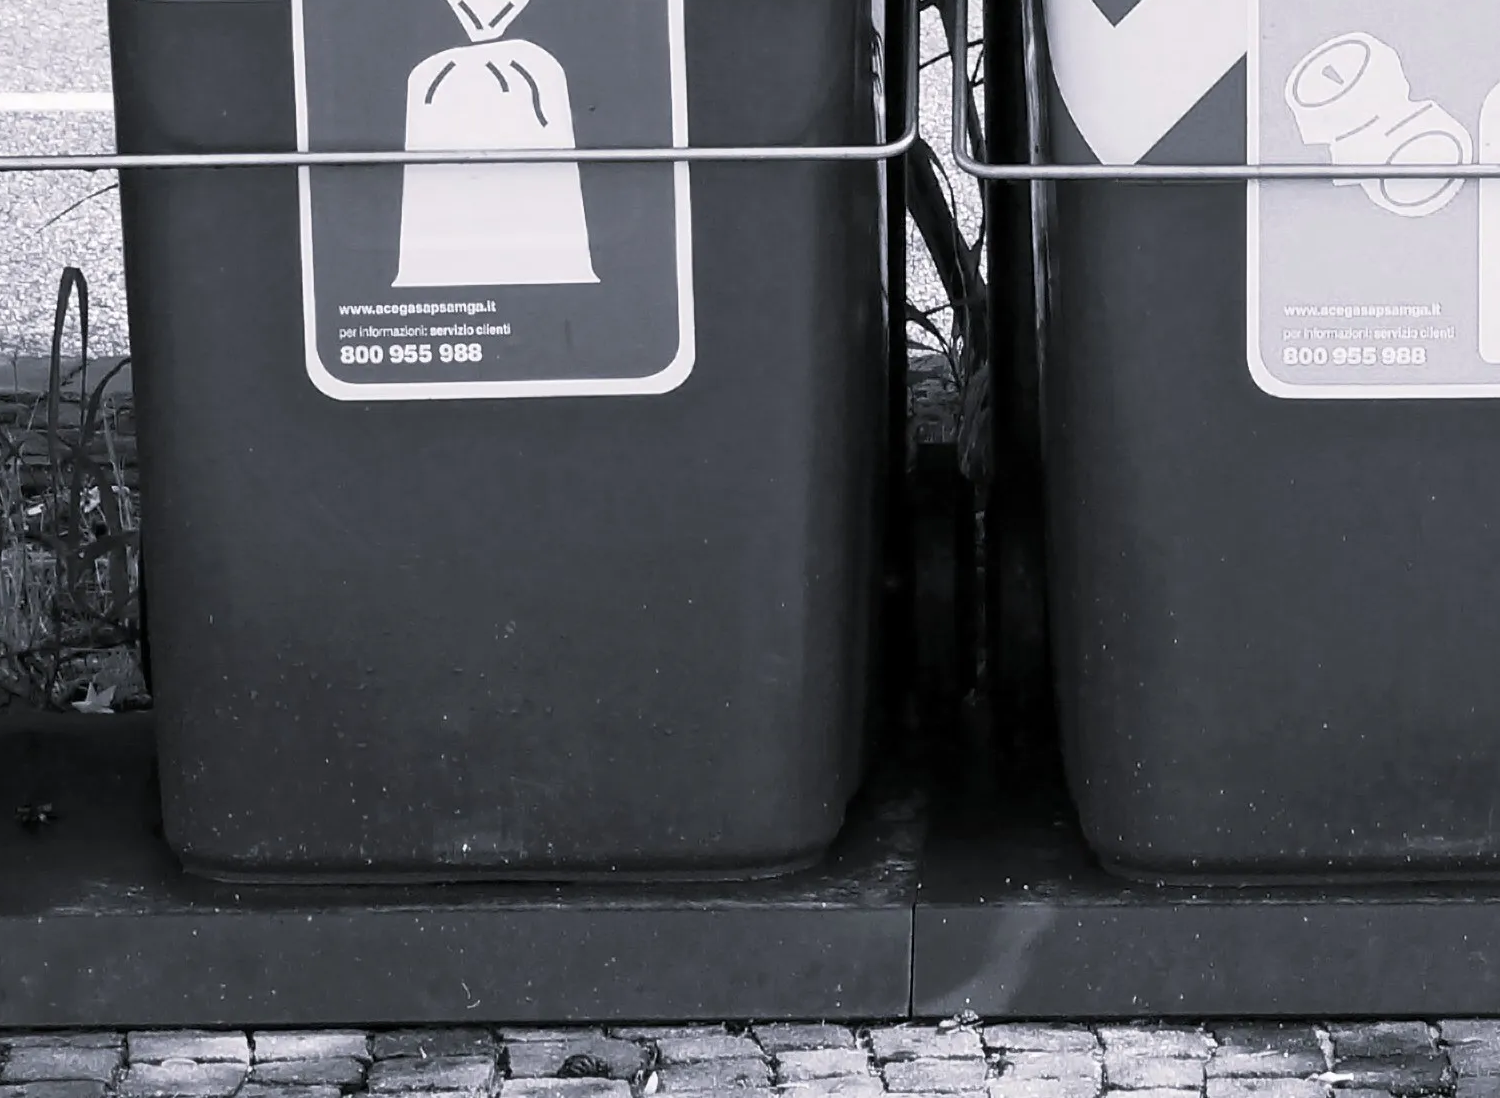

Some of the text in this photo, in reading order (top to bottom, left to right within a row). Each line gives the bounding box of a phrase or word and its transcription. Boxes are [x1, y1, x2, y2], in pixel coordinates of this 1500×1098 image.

[339, 327, 357, 340] per
[430, 323, 474, 336] servizio
[476, 323, 511, 335] clienti
[340, 343, 483, 364] 800 955 988
[1283, 347, 1426, 366] 800 955 988
